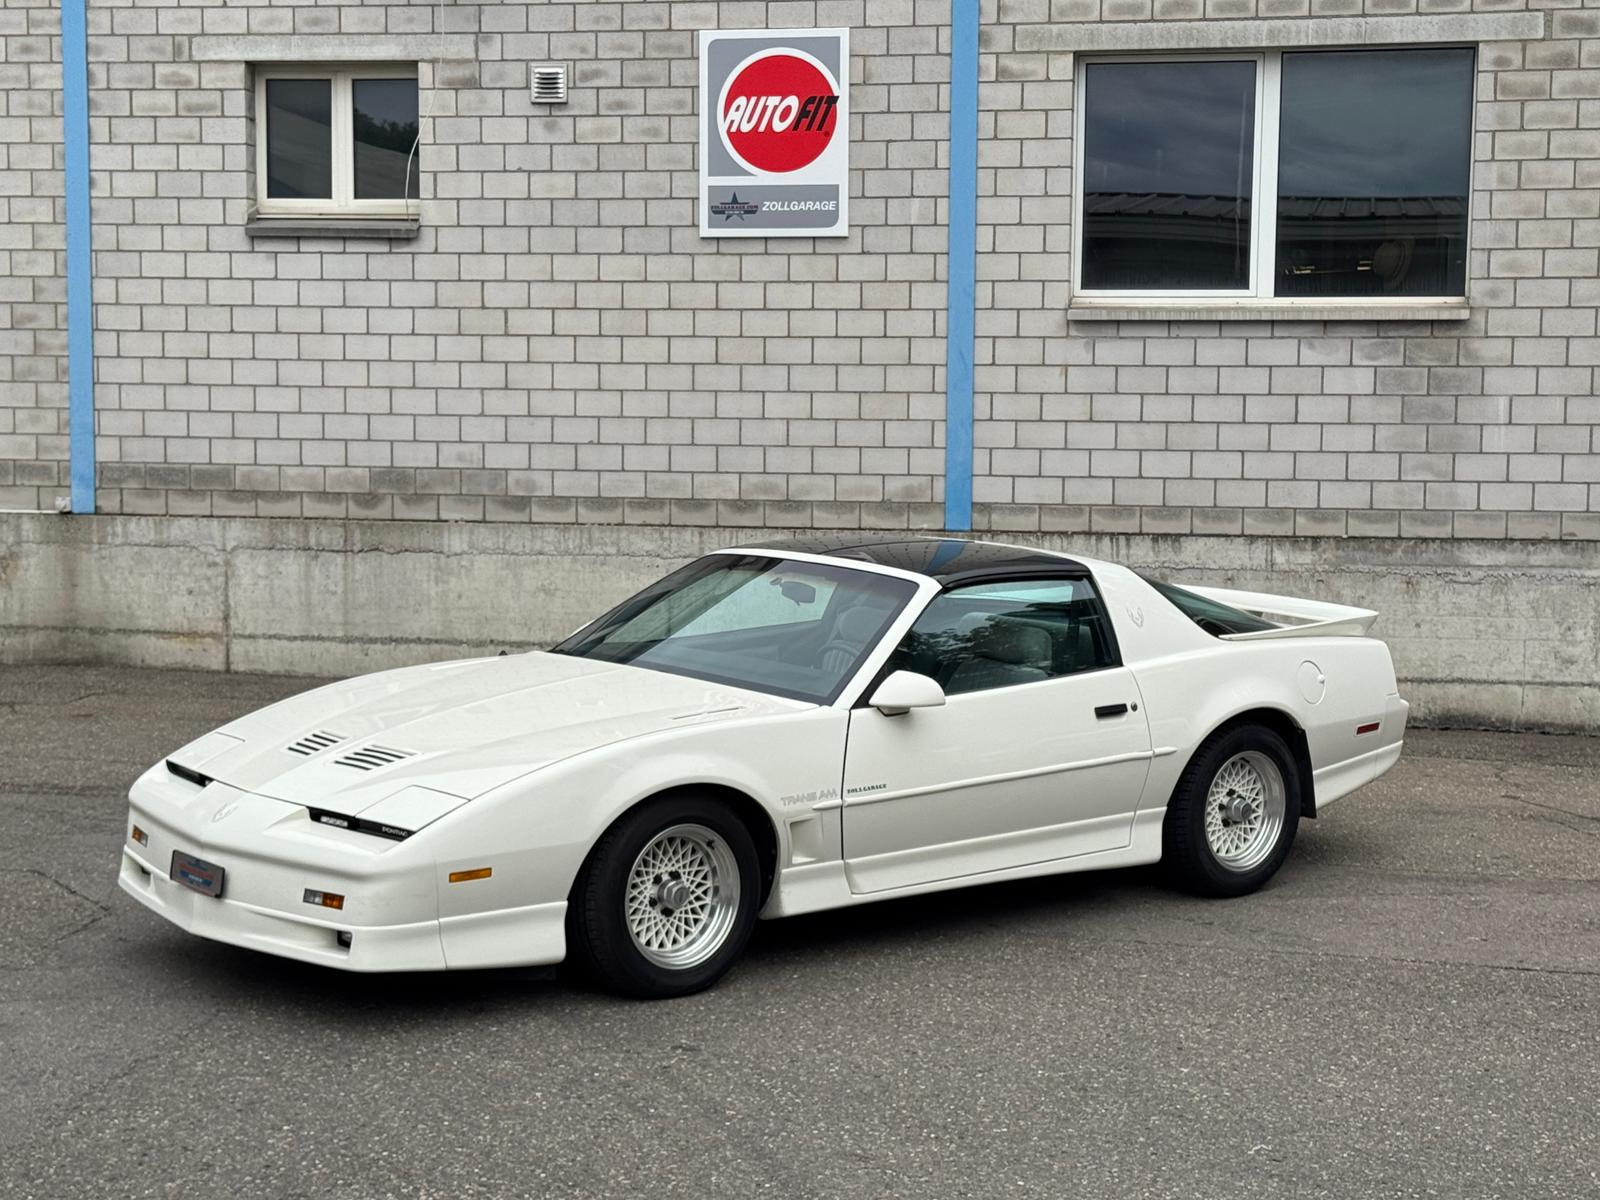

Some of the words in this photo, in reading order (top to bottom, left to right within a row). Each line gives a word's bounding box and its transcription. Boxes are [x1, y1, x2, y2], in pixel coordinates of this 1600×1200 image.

[726, 95, 840, 133] AUTOFIT
[762, 201, 837, 211] ZOLLGARAGE
[818, 788, 838, 800] AM
[847, 783, 887, 794] ZOLLGARAGE
